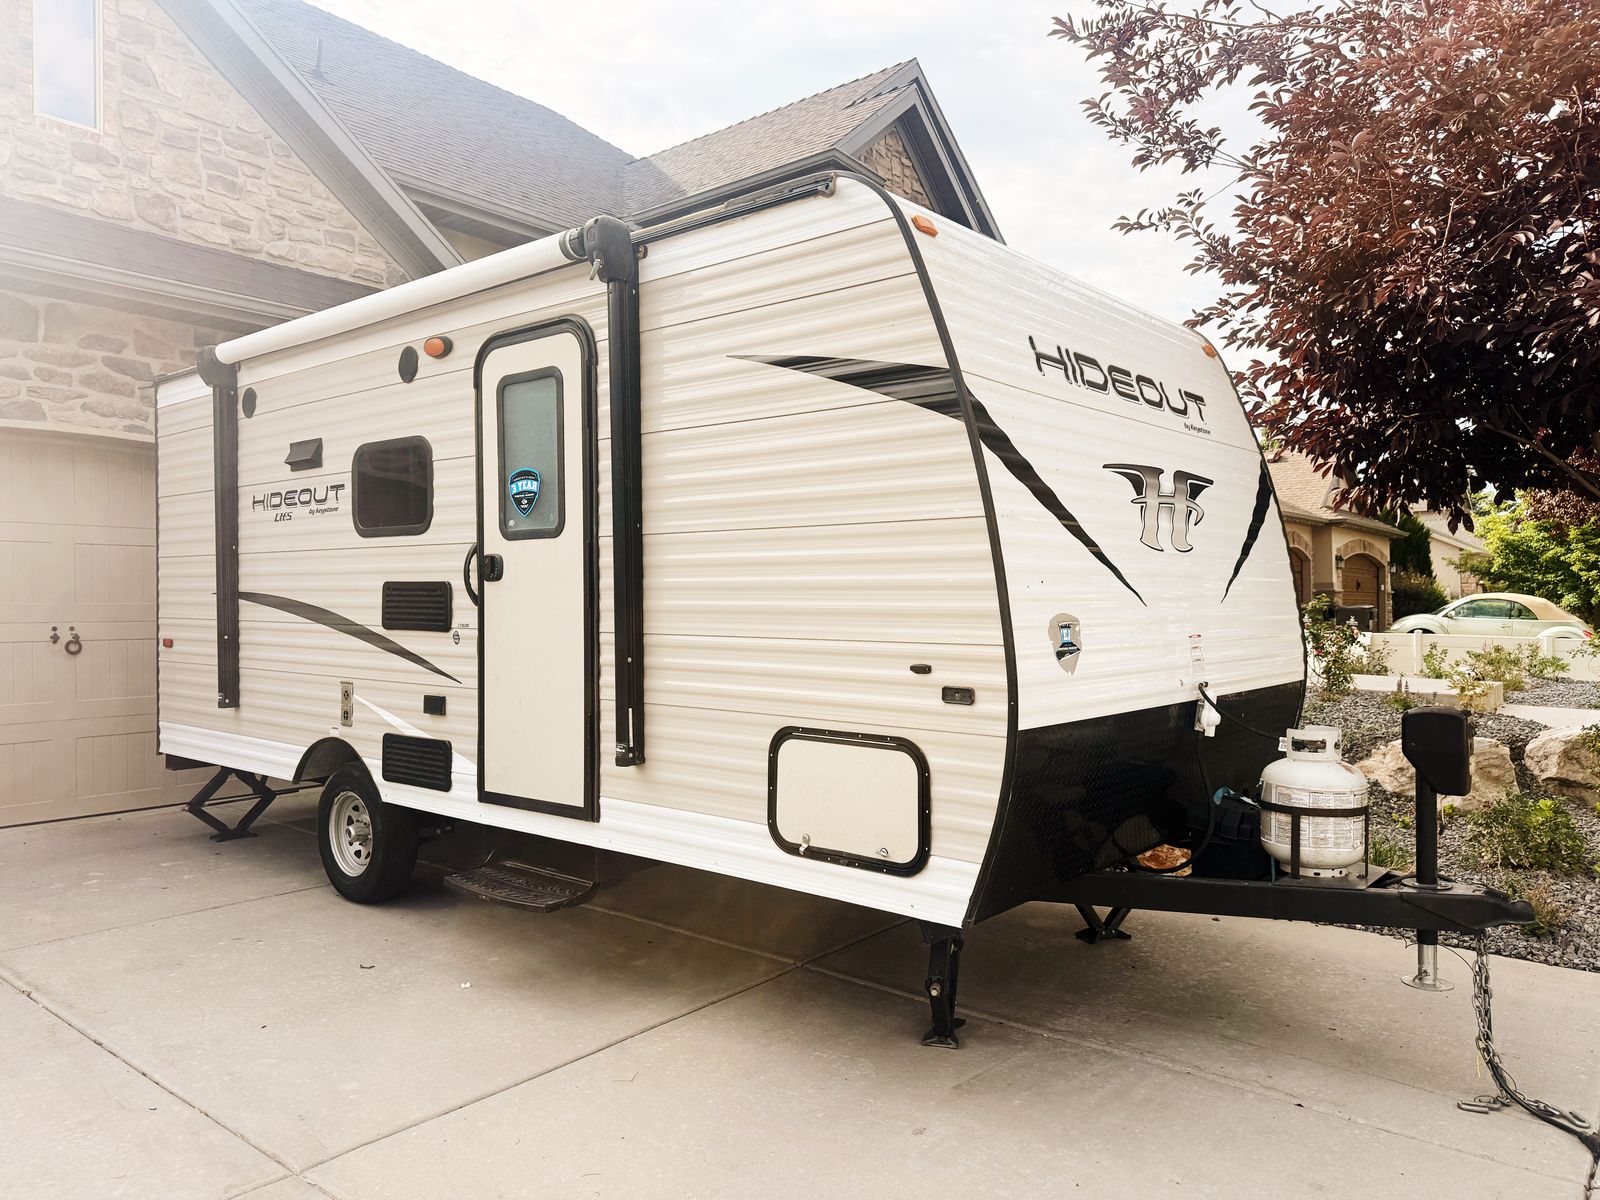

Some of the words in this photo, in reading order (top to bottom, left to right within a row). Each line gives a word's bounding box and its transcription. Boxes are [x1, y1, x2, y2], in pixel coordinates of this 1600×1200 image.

[1028, 335, 1206, 422] HIDEOUT
[252, 483, 345, 512] HIDEOUT
[518, 480, 537, 491] YEAR
